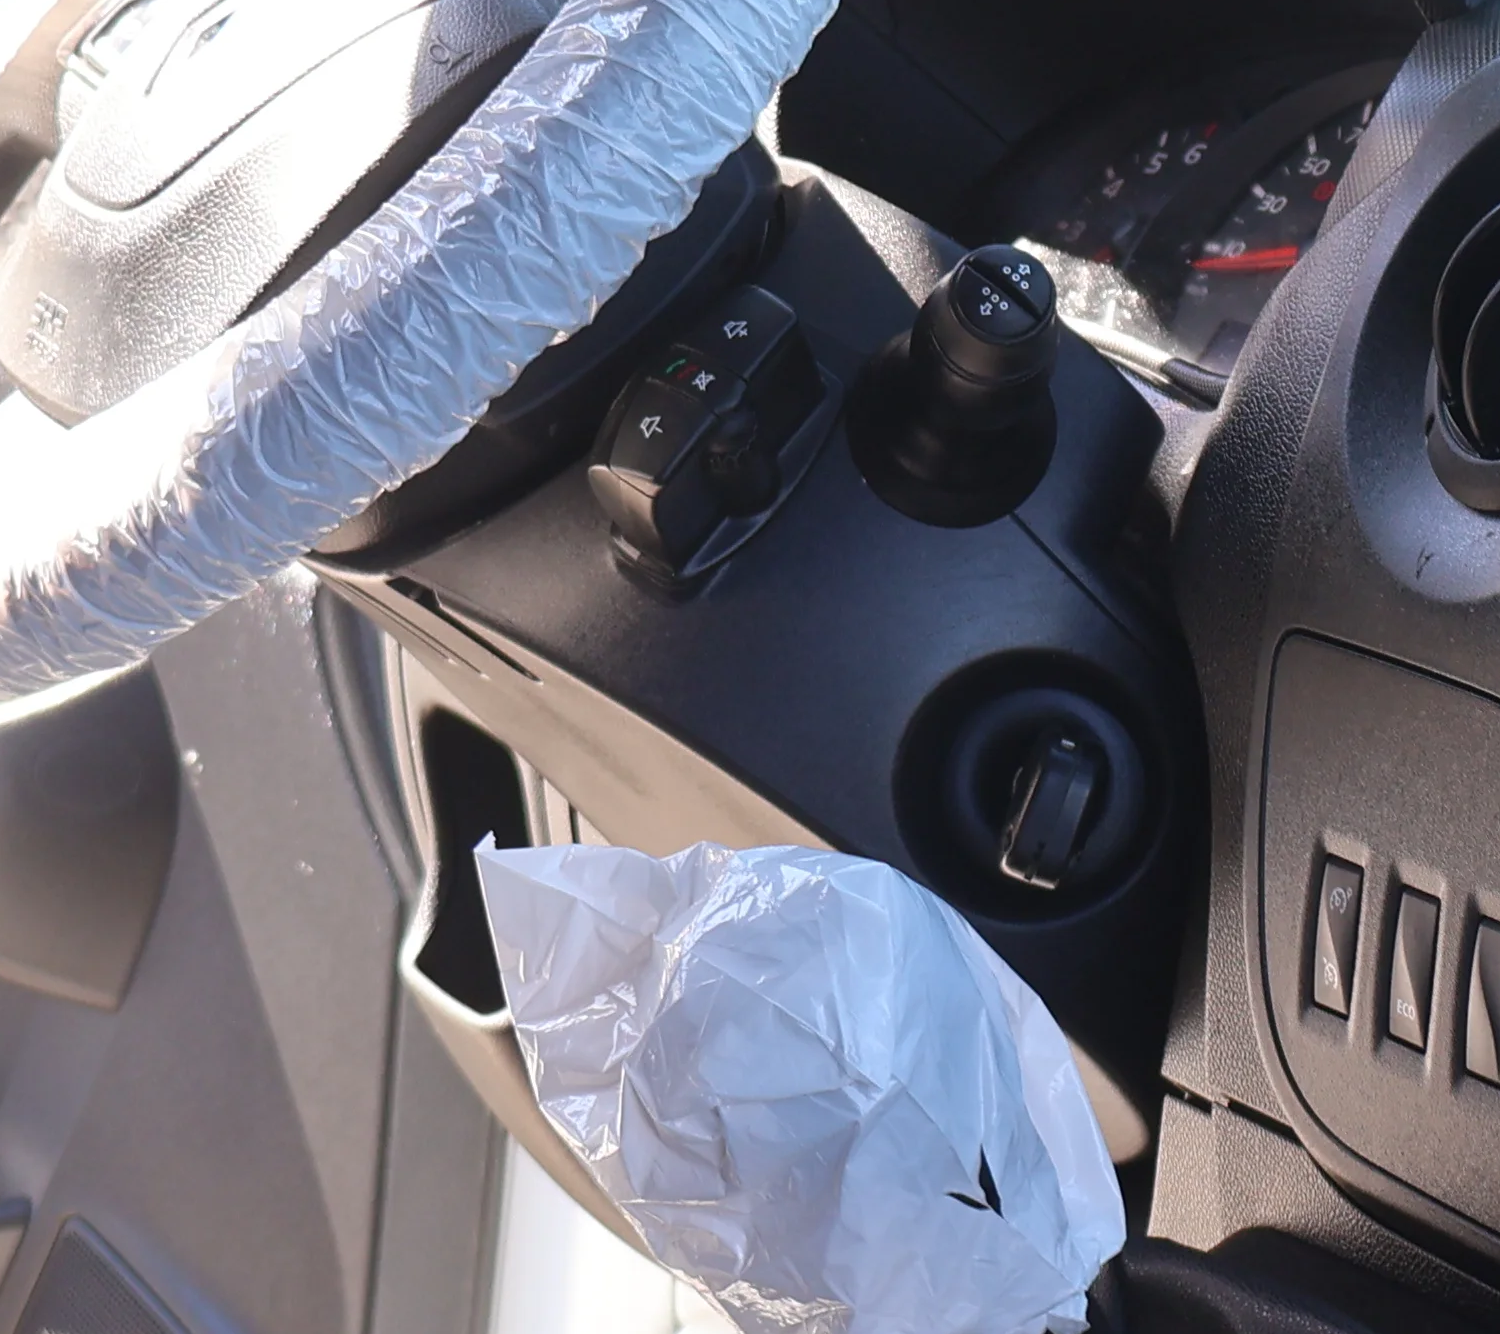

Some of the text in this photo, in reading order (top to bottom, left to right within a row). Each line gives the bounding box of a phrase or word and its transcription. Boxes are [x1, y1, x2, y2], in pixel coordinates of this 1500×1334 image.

[1143, 152, 1168, 175] 5
[1184, 143, 1207, 166] 6
[1299, 157, 1331, 177] 50
[1257, 194, 1288, 215] 30
